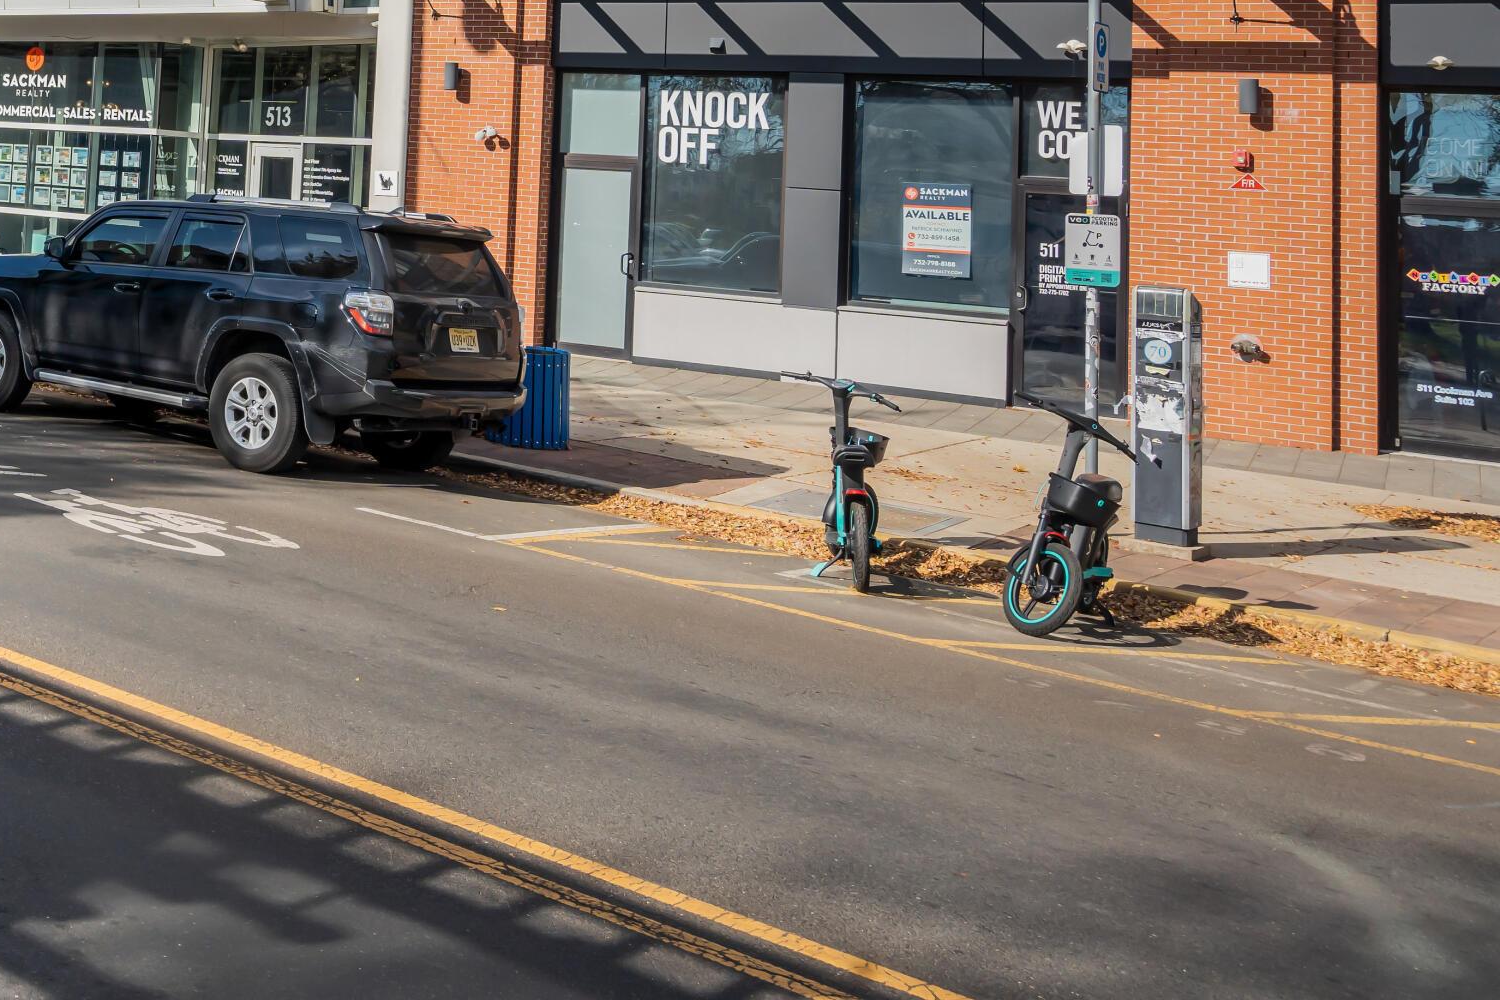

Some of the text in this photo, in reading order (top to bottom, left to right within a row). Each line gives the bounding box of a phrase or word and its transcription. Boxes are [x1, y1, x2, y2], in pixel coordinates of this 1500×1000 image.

[2, 74, 66, 88] SACKMAN
[16, 89, 50, 98] REALTY
[63, 106, 96, 120] SALES
[104, 108, 153, 122] RENTALS
[660, 90, 770, 129] KNOCK
[1037, 100, 1082, 129] WE
[265, 106, 292, 127] 513
[658, 126, 719, 164] OFF
[1038, 130, 1079, 159] CO
[1241, 179, 1255, 188] F/R
[217, 188, 244, 197] SACKMAN
[920, 188, 968, 196] SACKMAN
[905, 210, 969, 221] AVAILABLE
[1040, 243, 1059, 258] 511
[1039, 274, 1063, 284] PRINT
[1409, 270, 1499, 285] NOSTALGIA
[1422, 283, 1487, 295] FACTORY
[1150, 345, 1167, 358] 70
[1416, 384, 1432, 392] 511
[1458, 398, 1475, 406] 102
